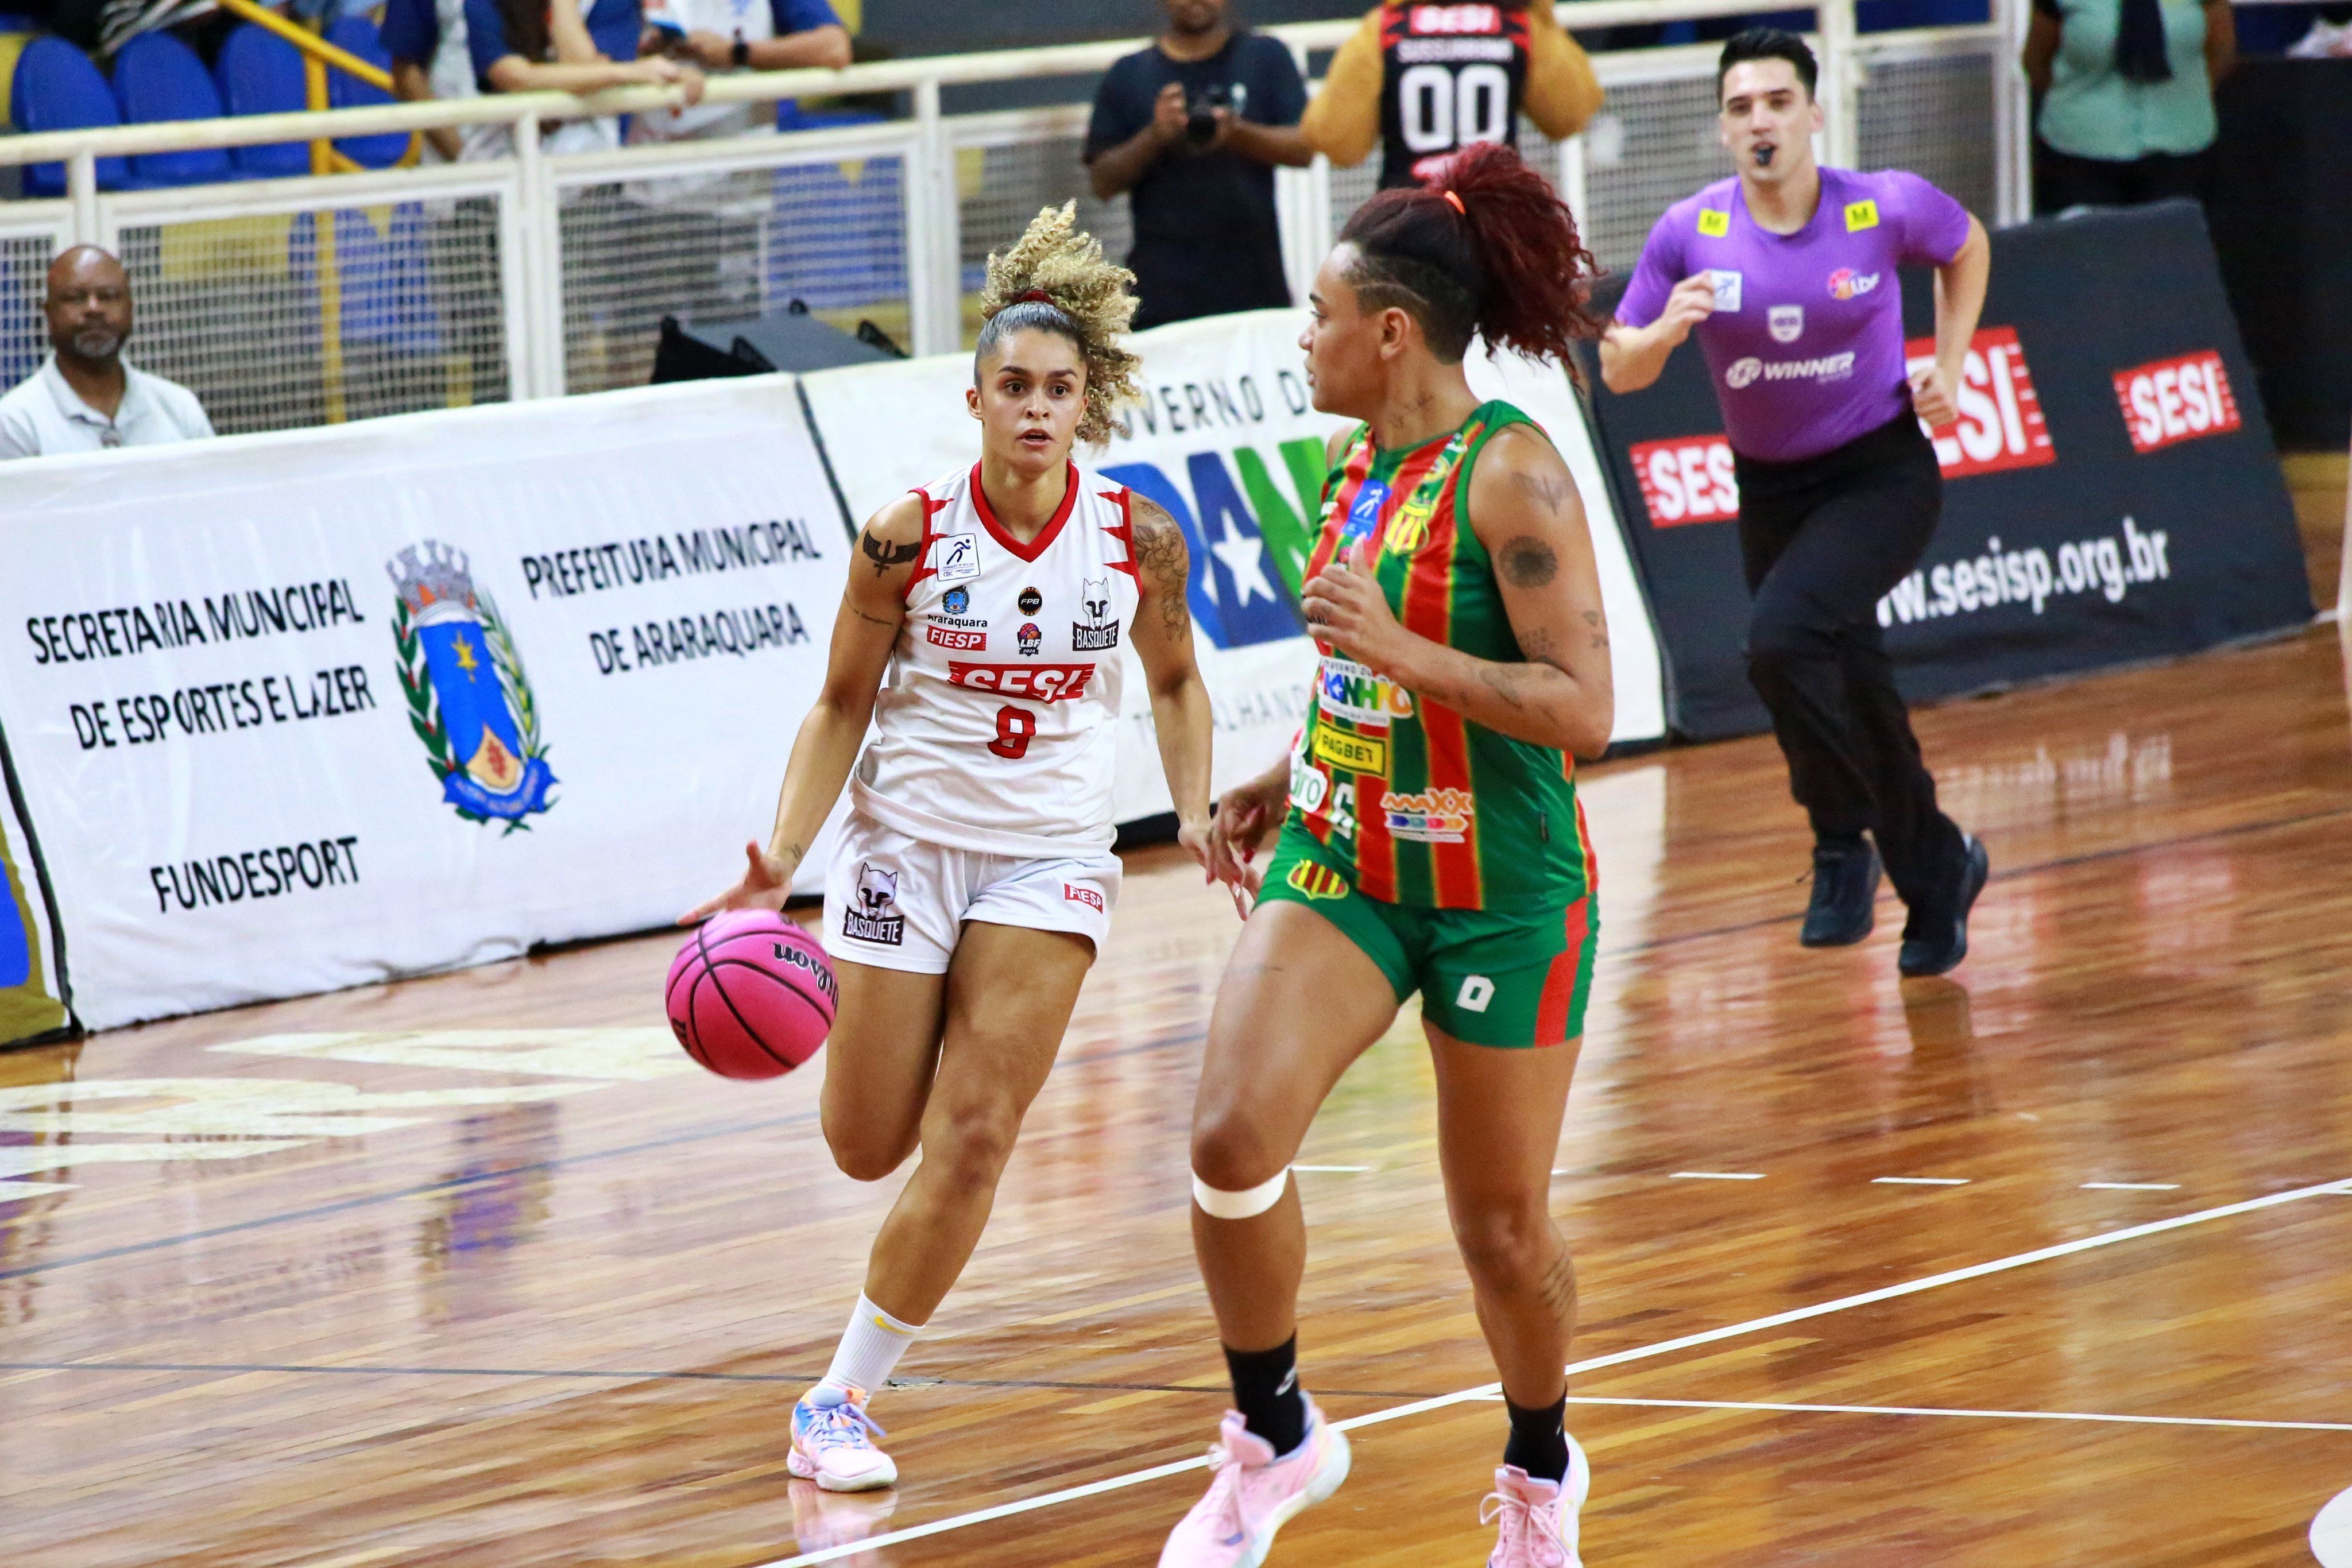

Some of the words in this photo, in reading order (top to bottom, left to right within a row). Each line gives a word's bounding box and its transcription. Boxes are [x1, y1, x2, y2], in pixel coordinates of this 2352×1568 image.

[1399, 65, 1509, 153] 00
[1764, 351, 1856, 380] WINNER
[2130, 361, 2225, 446] SESI
[1648, 444, 1740, 520] SES
[521, 535, 682, 600] PREFEITURA
[676, 518, 822, 574] MUNICIPAL
[26, 601, 206, 665] SECRETARIA
[589, 629, 631, 675] DE
[632, 602, 810, 668] ARARAQUARA
[930, 629, 982, 648] FIESP
[1020, 638, 1040, 648] LBF
[1076, 626, 1117, 649] BASQUETE
[964, 669, 1082, 702] SESI
[71, 702, 116, 750] DE
[117, 680, 262, 745] ESPORTES
[262, 677, 288, 722] E
[1321, 734, 1374, 764] PAGBET
[150, 837, 361, 913] FUNDESPORT
[1069, 886, 1102, 908] FIESP
[846, 912, 901, 943] BASQUETE
